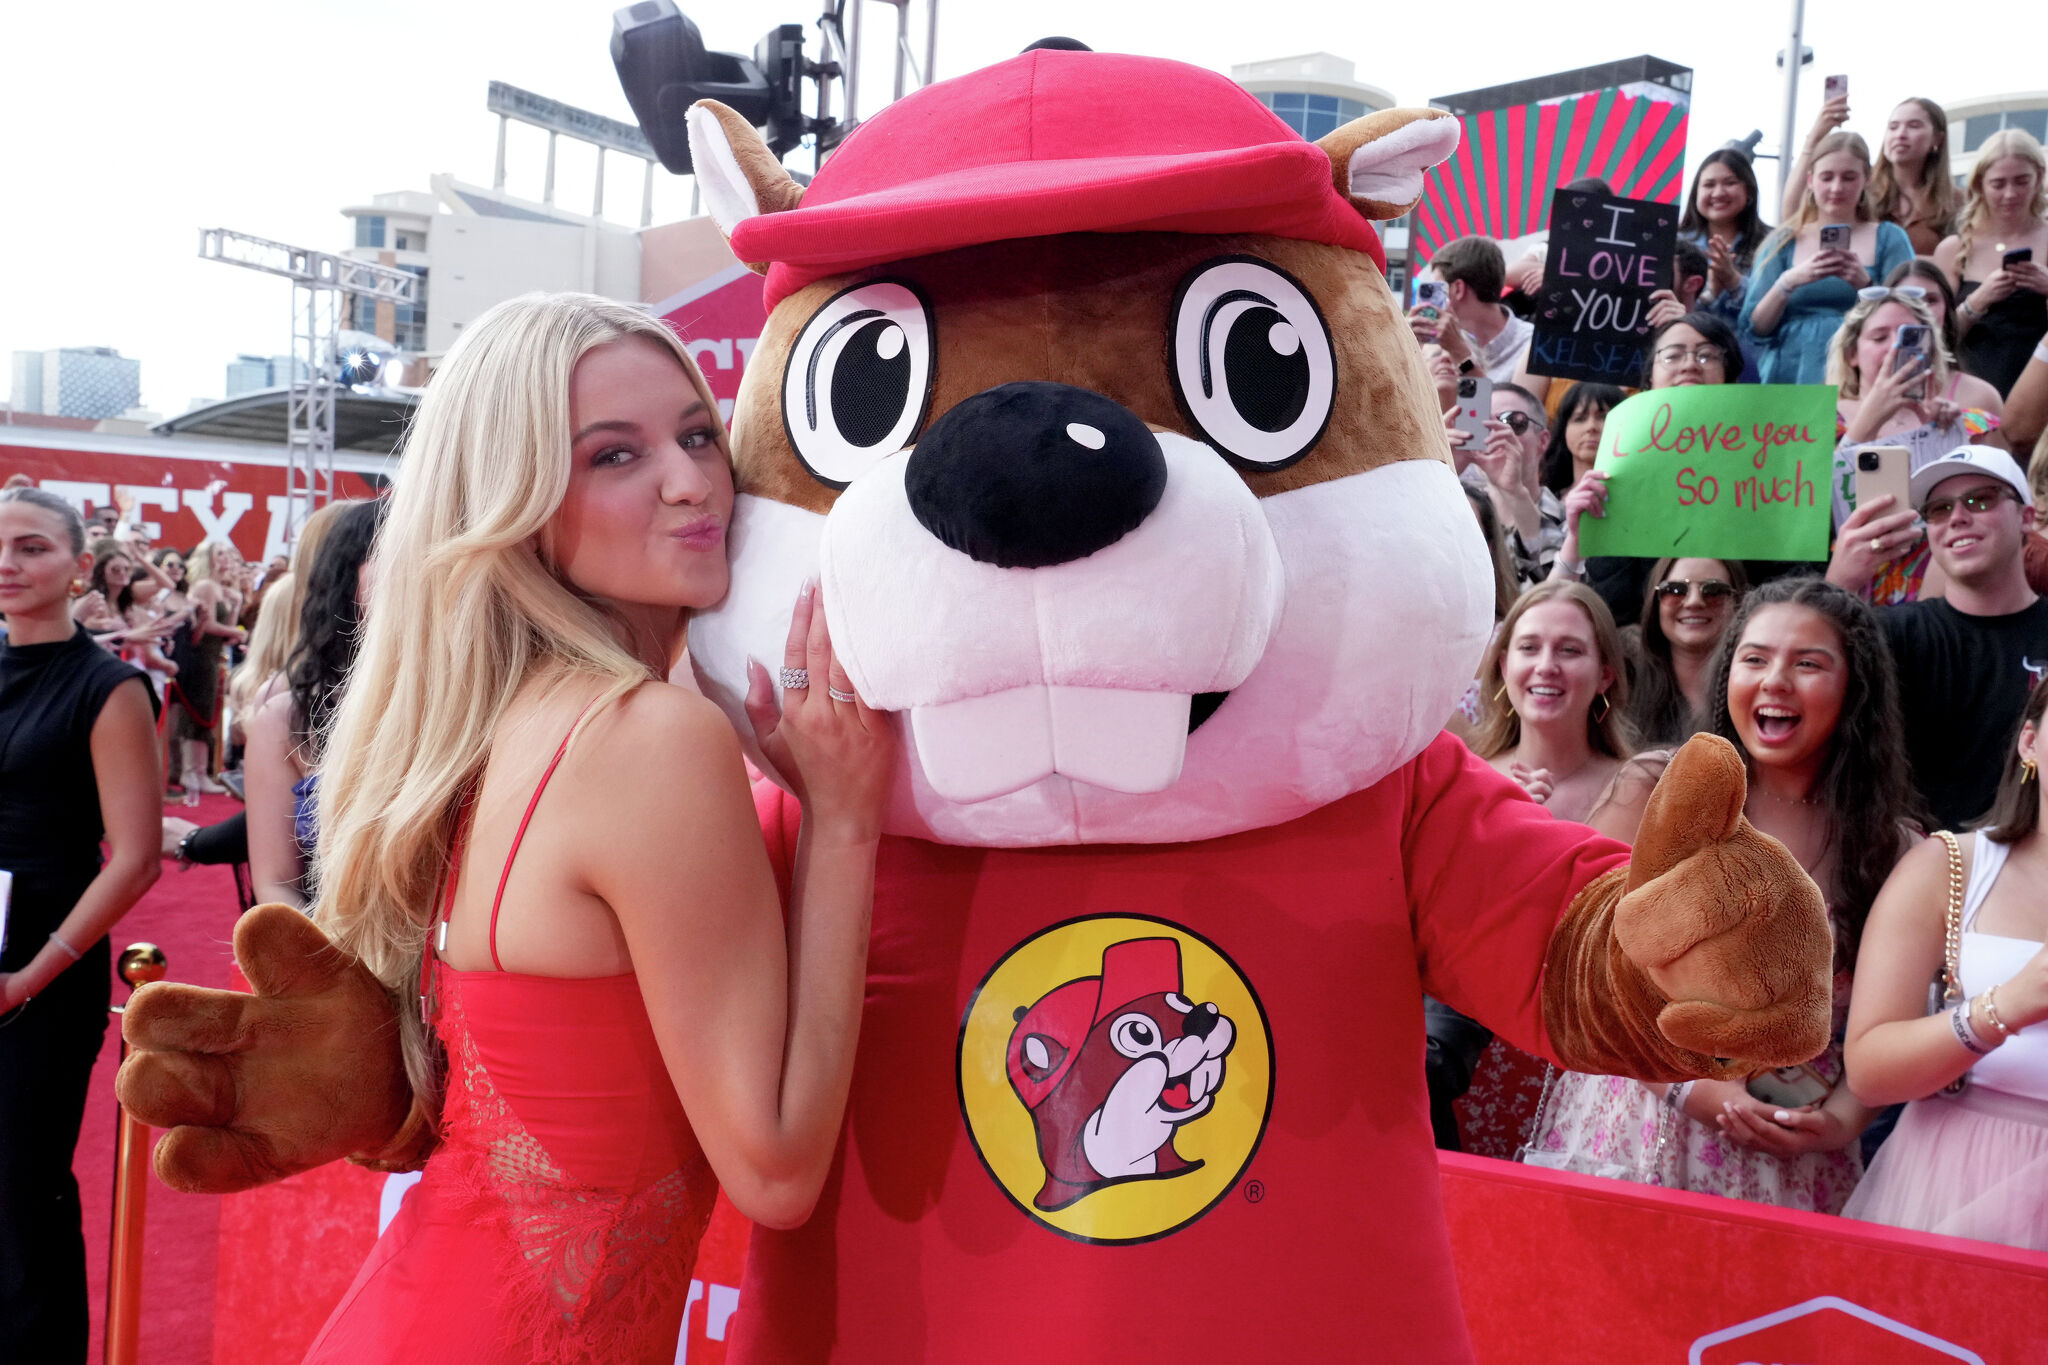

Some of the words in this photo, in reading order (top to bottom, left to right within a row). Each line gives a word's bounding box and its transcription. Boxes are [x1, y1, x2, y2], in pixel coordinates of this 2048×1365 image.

[1594, 204, 1636, 247] I
[1559, 248, 1658, 287] LOVE
[1571, 288, 1641, 333] YOU
[1533, 332, 1643, 374] KELSEA
[1638, 403, 1747, 454] love
[1753, 422, 1818, 469] you
[1735, 460, 1815, 511] much
